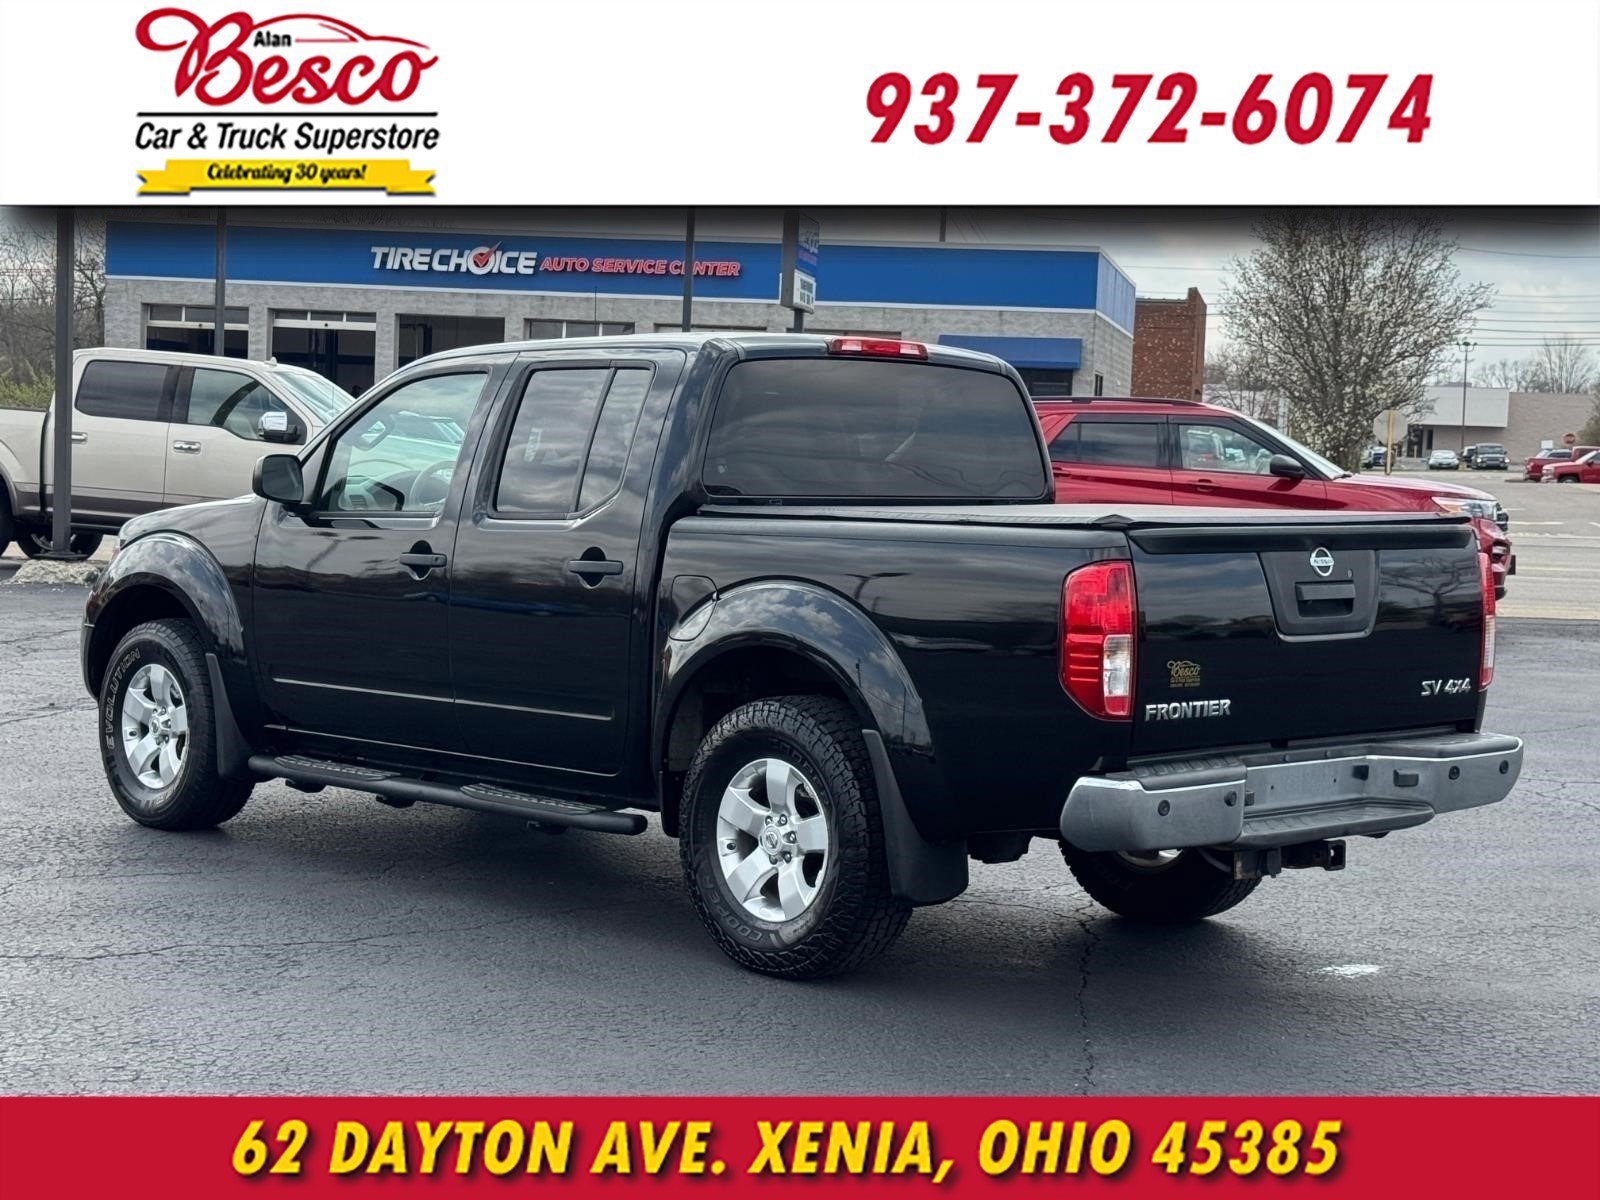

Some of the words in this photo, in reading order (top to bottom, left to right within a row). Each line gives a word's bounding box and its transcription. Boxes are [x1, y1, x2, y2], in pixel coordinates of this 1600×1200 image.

[539, 256, 589, 272] AUTO
[591, 258, 667, 274] SERVICE
[1421, 679, 1443, 697] SV
[1144, 698, 1231, 722] FRONTIER
